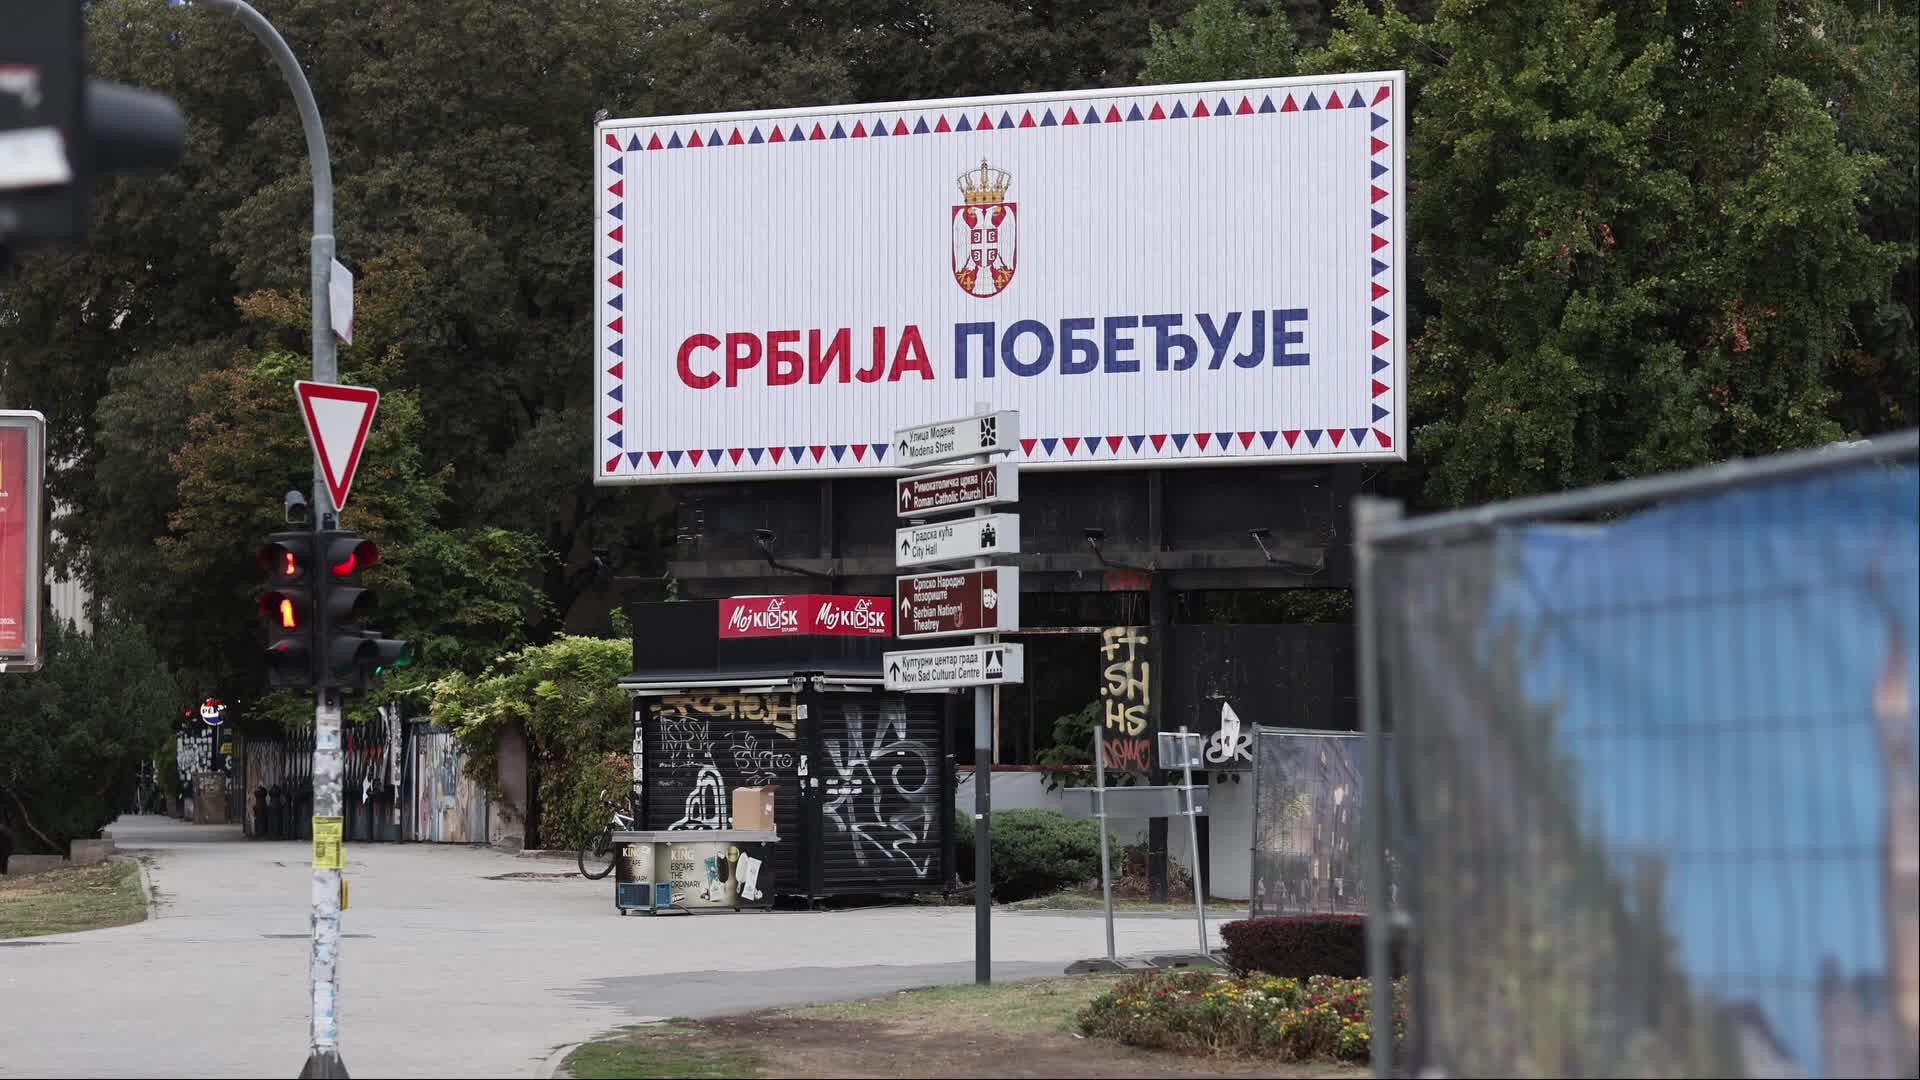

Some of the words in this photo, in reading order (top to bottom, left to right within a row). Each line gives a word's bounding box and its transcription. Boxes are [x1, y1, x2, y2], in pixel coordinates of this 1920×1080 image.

[676, 324, 935, 390] СРБИЈА
[954, 308, 1311, 380] ПОБЕЂУЈЕ
[909, 430, 929, 443] Улица
[930, 426, 955, 439] Модене
[909, 444, 934, 457] Modena
[936, 440, 955, 453] Street
[913, 477, 960, 493] Римокатоличка
[960, 474, 978, 488] црква
[913, 494, 934, 508] Roman
[935, 489, 959, 505] Catholic
[959, 487, 981, 501] Church
[912, 529, 937, 544] Градска
[938, 526, 953, 541] кућа
[912, 545, 924, 558] City
[925, 544, 938, 556] Hall
[913, 577, 936, 590] Српско
[937, 575, 965, 588] Народно
[913, 590, 948, 602] позориште
[913, 606, 936, 618] Serbian
[902, 656, 933, 669] Културни
[934, 655, 958, 667] центар
[958, 653, 978, 665] града
[902, 671, 917, 682] Novi
[918, 670, 930, 681] Sad
[931, 668, 956, 681] Cultural
[958, 667, 980, 679] Centre
[671, 848, 695, 860] KING
[671, 862, 695, 871] ESCAPE
[671, 872, 684, 880] THE
[671, 880, 700, 889] ORDINARY
